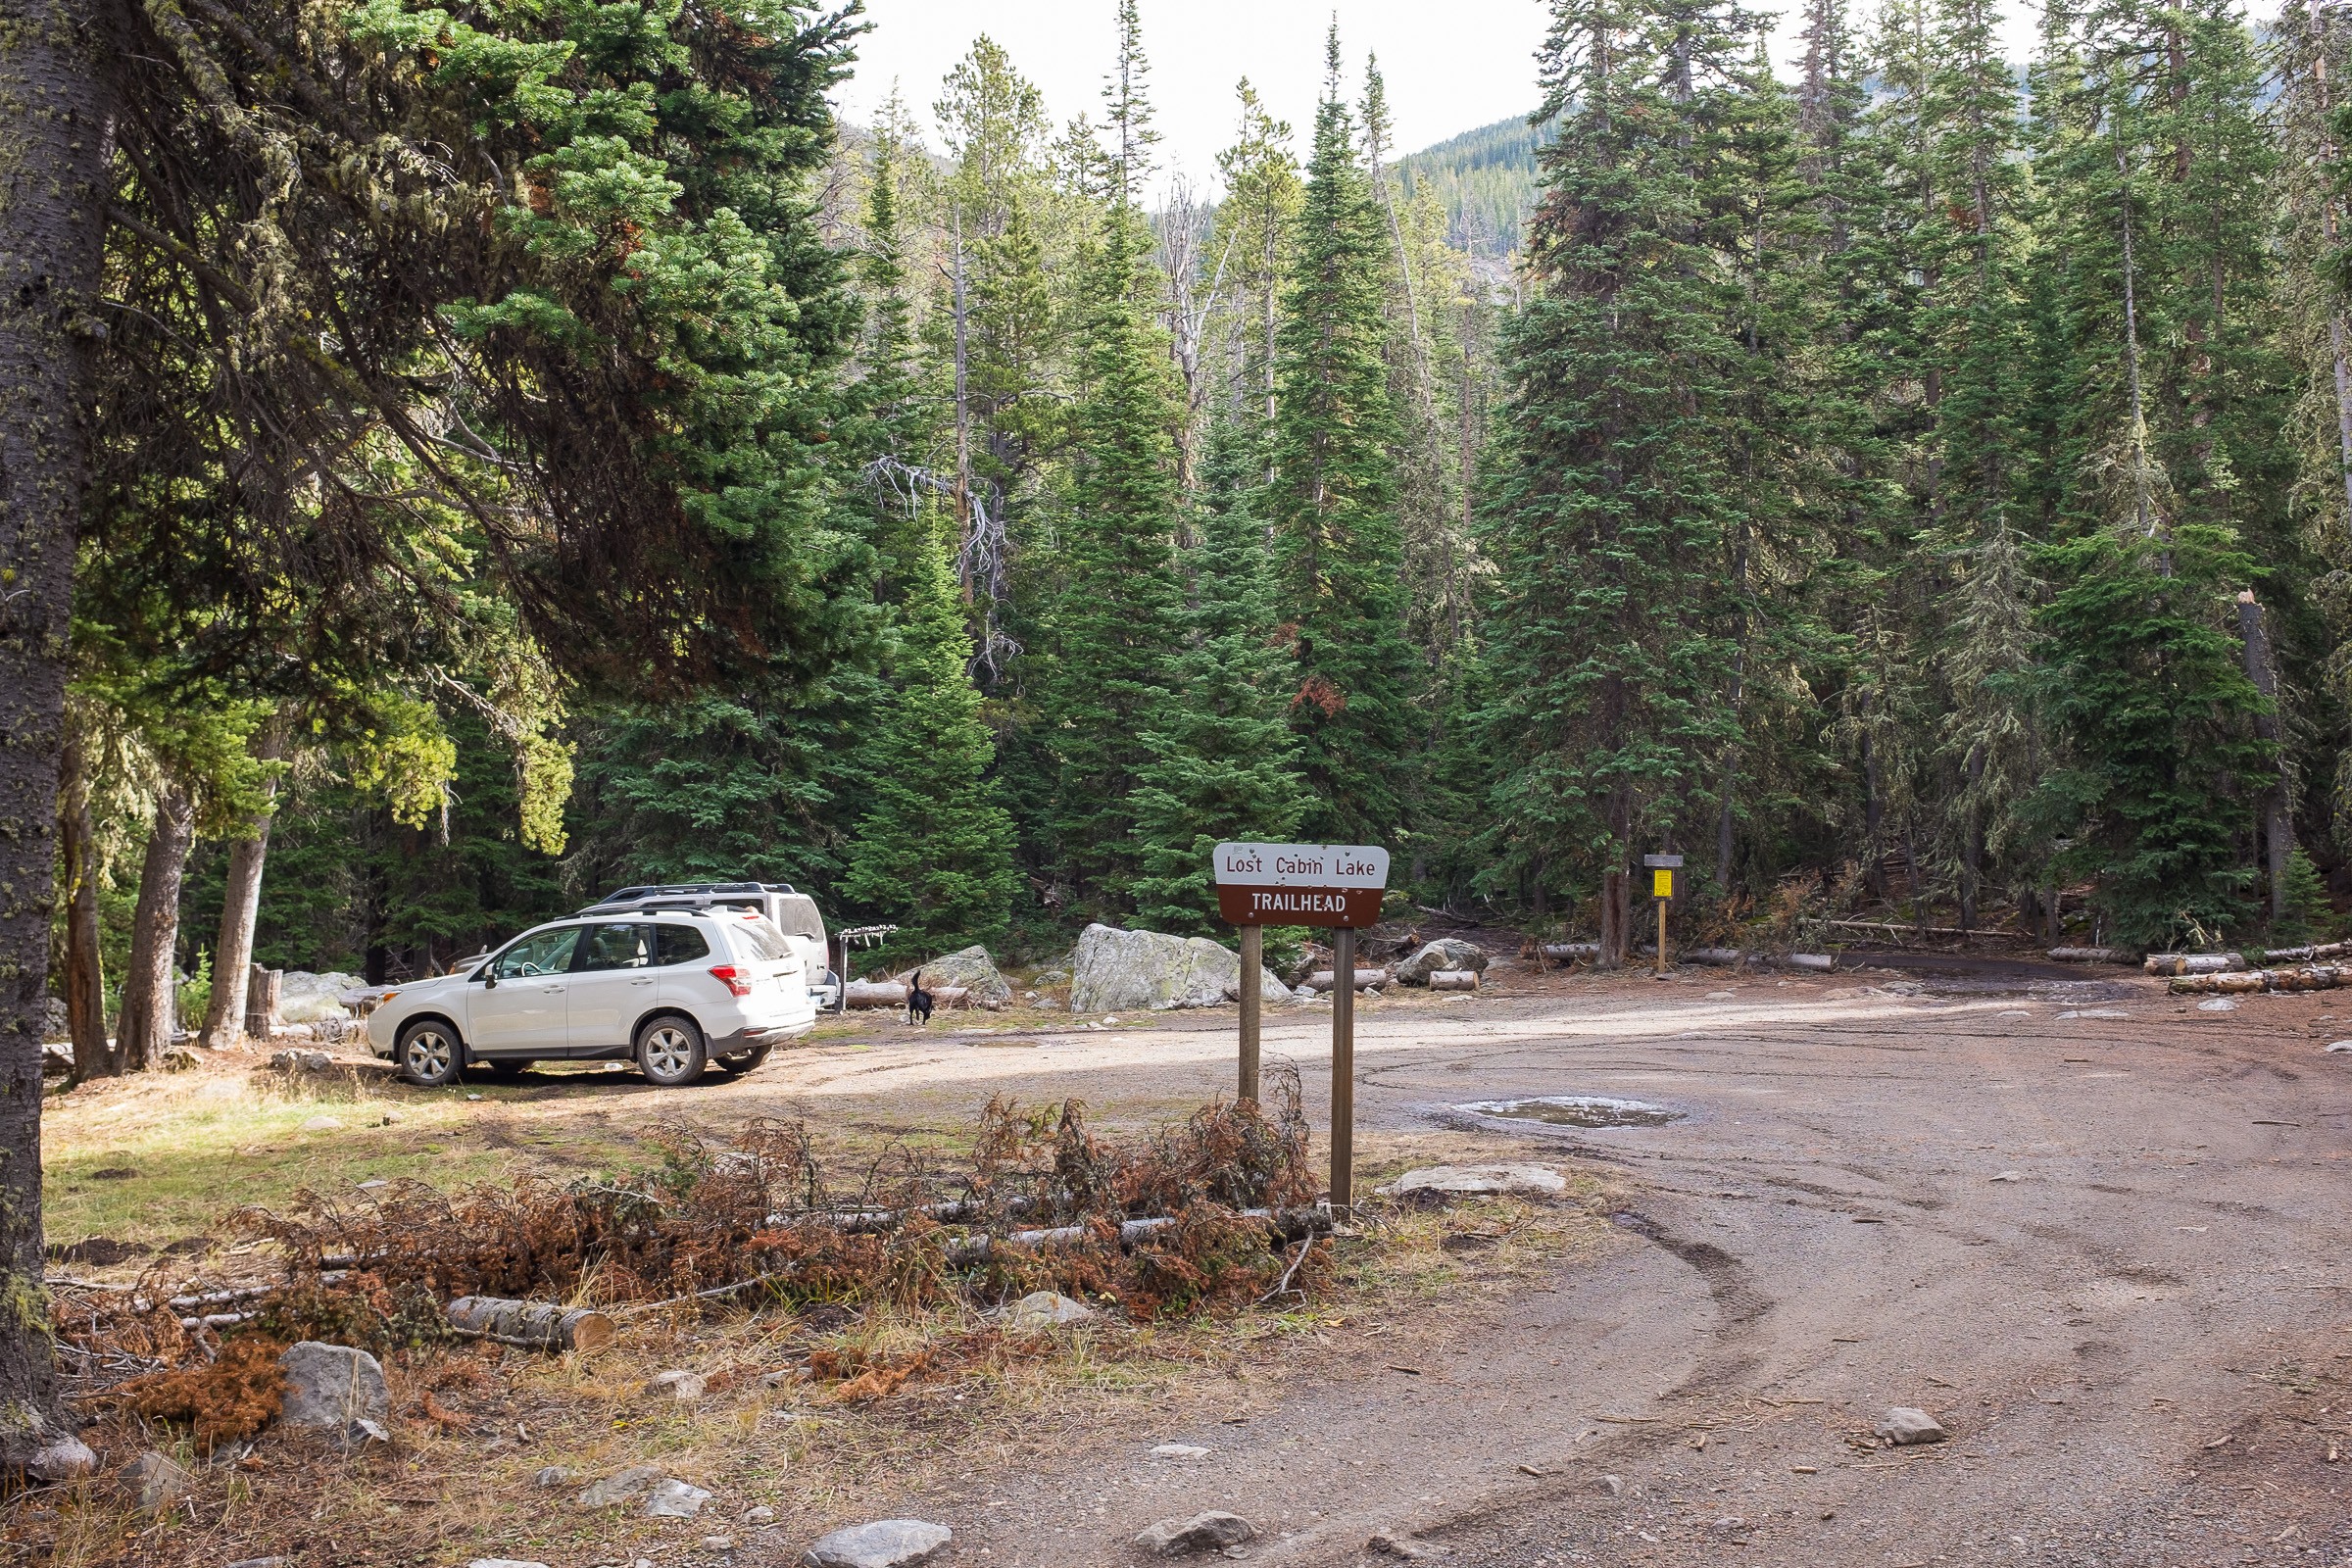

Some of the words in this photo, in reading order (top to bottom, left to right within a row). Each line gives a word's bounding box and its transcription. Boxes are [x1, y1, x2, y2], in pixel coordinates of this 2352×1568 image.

[1227, 856, 1262, 873] Lost
[1276, 857, 1322, 875] Cabin
[1336, 858, 1375, 876] Lake
[1252, 893, 1346, 912] TRAILHEAD
